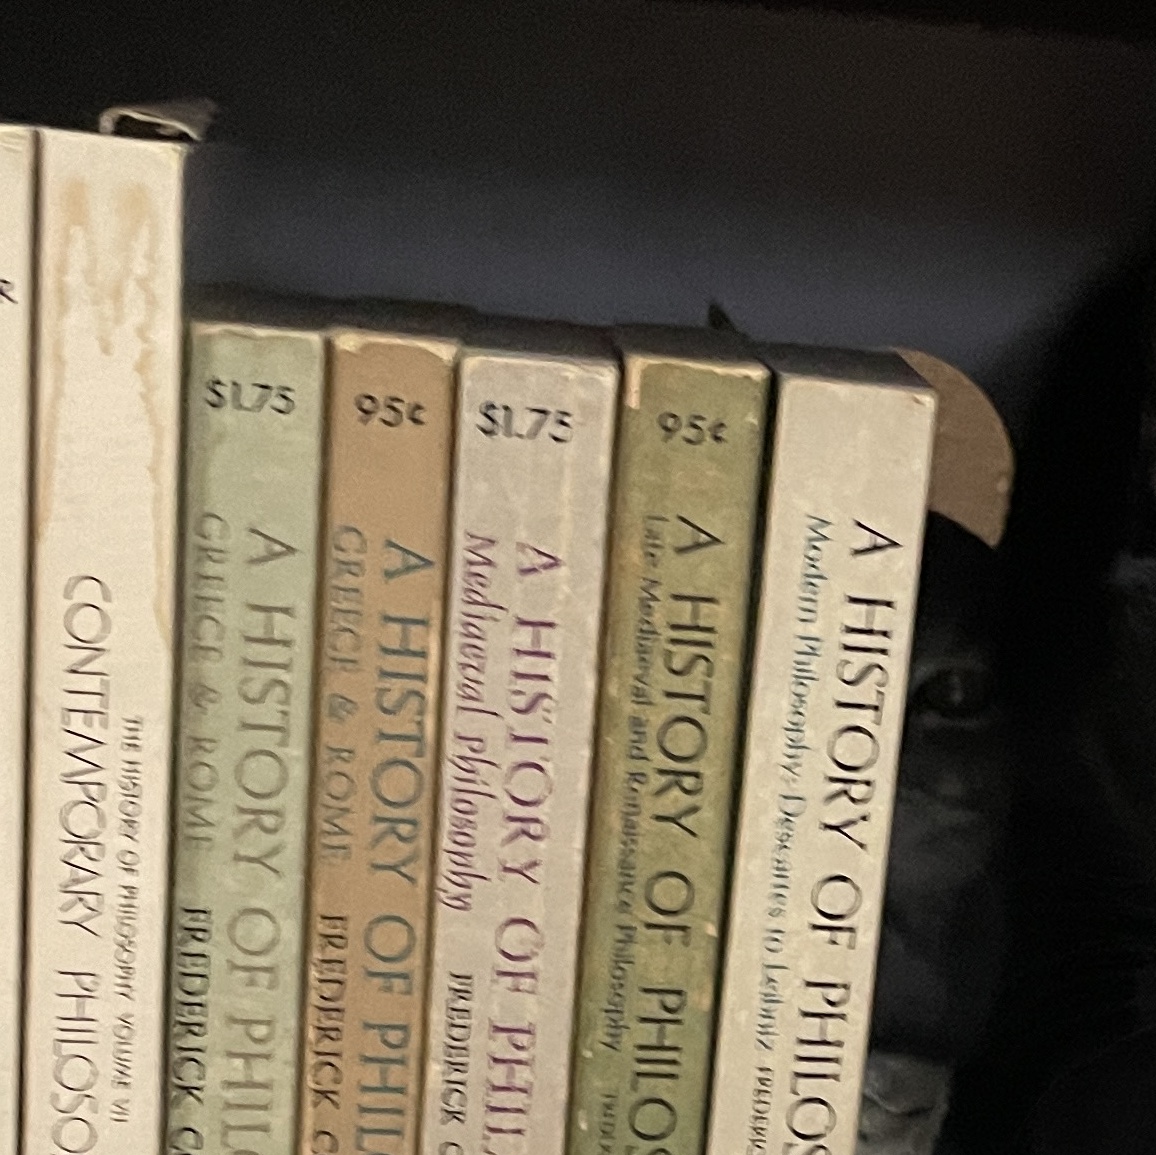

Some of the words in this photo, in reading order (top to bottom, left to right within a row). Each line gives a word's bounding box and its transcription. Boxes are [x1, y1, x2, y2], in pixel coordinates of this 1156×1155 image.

[204, 377, 296, 415] $1.75
[355, 392, 426, 428] 95¢
[476, 401, 574, 444] $1.75
[657, 411, 729, 445] 95¢
[246, 527, 298, 565] A
[382, 539, 436, 585] A
[516, 540, 566, 577] A
[641, 514, 669, 568] Late
[675, 514, 724, 556] A
[796, 513, 834, 623] Modern
[851, 517, 905, 558] A
[190, 511, 232, 666] GREECE
[328, 523, 368, 673] GREECE
[630, 577, 662, 705] Mediaeval
[58, 575, 112, 937] CONTEMPORARY
[120, 715, 144, 752] THE
[232, 602, 296, 878] HISTORY
[368, 613, 431, 887] HISTORY
[500, 616, 558, 886] HISTORY
[627, 715, 655, 760] and
[653, 591, 721, 838] HISTORY
[818, 594, 895, 850] HISTORY
[117, 758, 143, 842] HISTORY
[183, 736, 220, 852] ROME
[321, 745, 356, 862] ROME
[435, 730, 501, 912] Philosophy
[115, 849, 141, 877] OF
[616, 772, 647, 915] Renaissance
[767, 793, 807, 918] Descartes
[112, 884, 140, 1001] PHILOSOPHY
[226, 906, 280, 990] OF
[643, 869, 696, 948] OF
[763, 927, 790, 954] to
[808, 872, 863, 950] OF
[363, 913, 417, 998] OF
[494, 916, 545, 993] OF
[600, 923, 637, 1052] Philosophy
[172, 907, 212, 1106] FREDERICK
[312, 913, 348, 1110] FREDERICK
[439, 971, 474, 1126] FREDERICK
[755, 963, 791, 1051] Leibniz
[110, 1012, 135, 1089] VOLUME
[109, 1097, 133, 1123] VII
